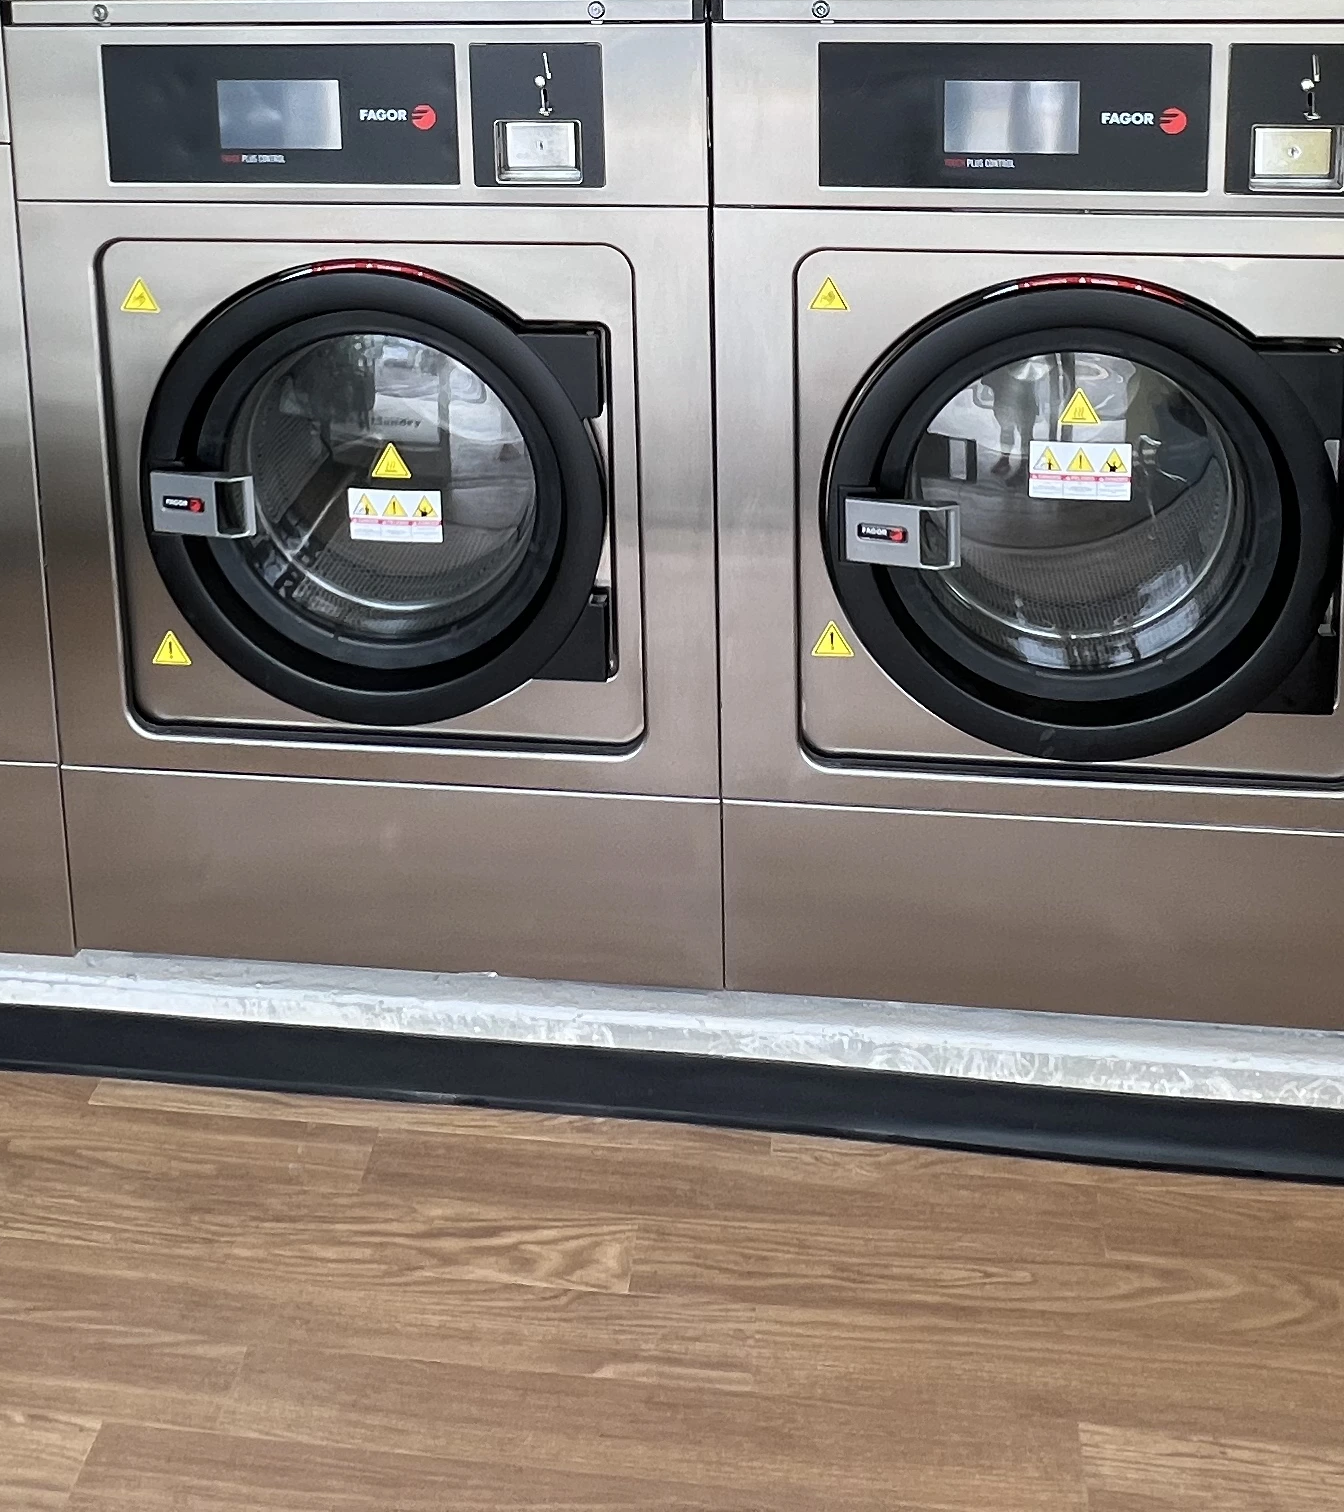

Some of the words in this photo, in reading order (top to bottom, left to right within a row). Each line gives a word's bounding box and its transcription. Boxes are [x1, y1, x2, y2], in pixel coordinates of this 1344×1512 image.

[359, 109, 407, 122] FAGOR
[1101, 112, 1155, 125] FAGOR
[966, 158, 983, 168] PLUS
[861, 527, 887, 536] FAGOR
